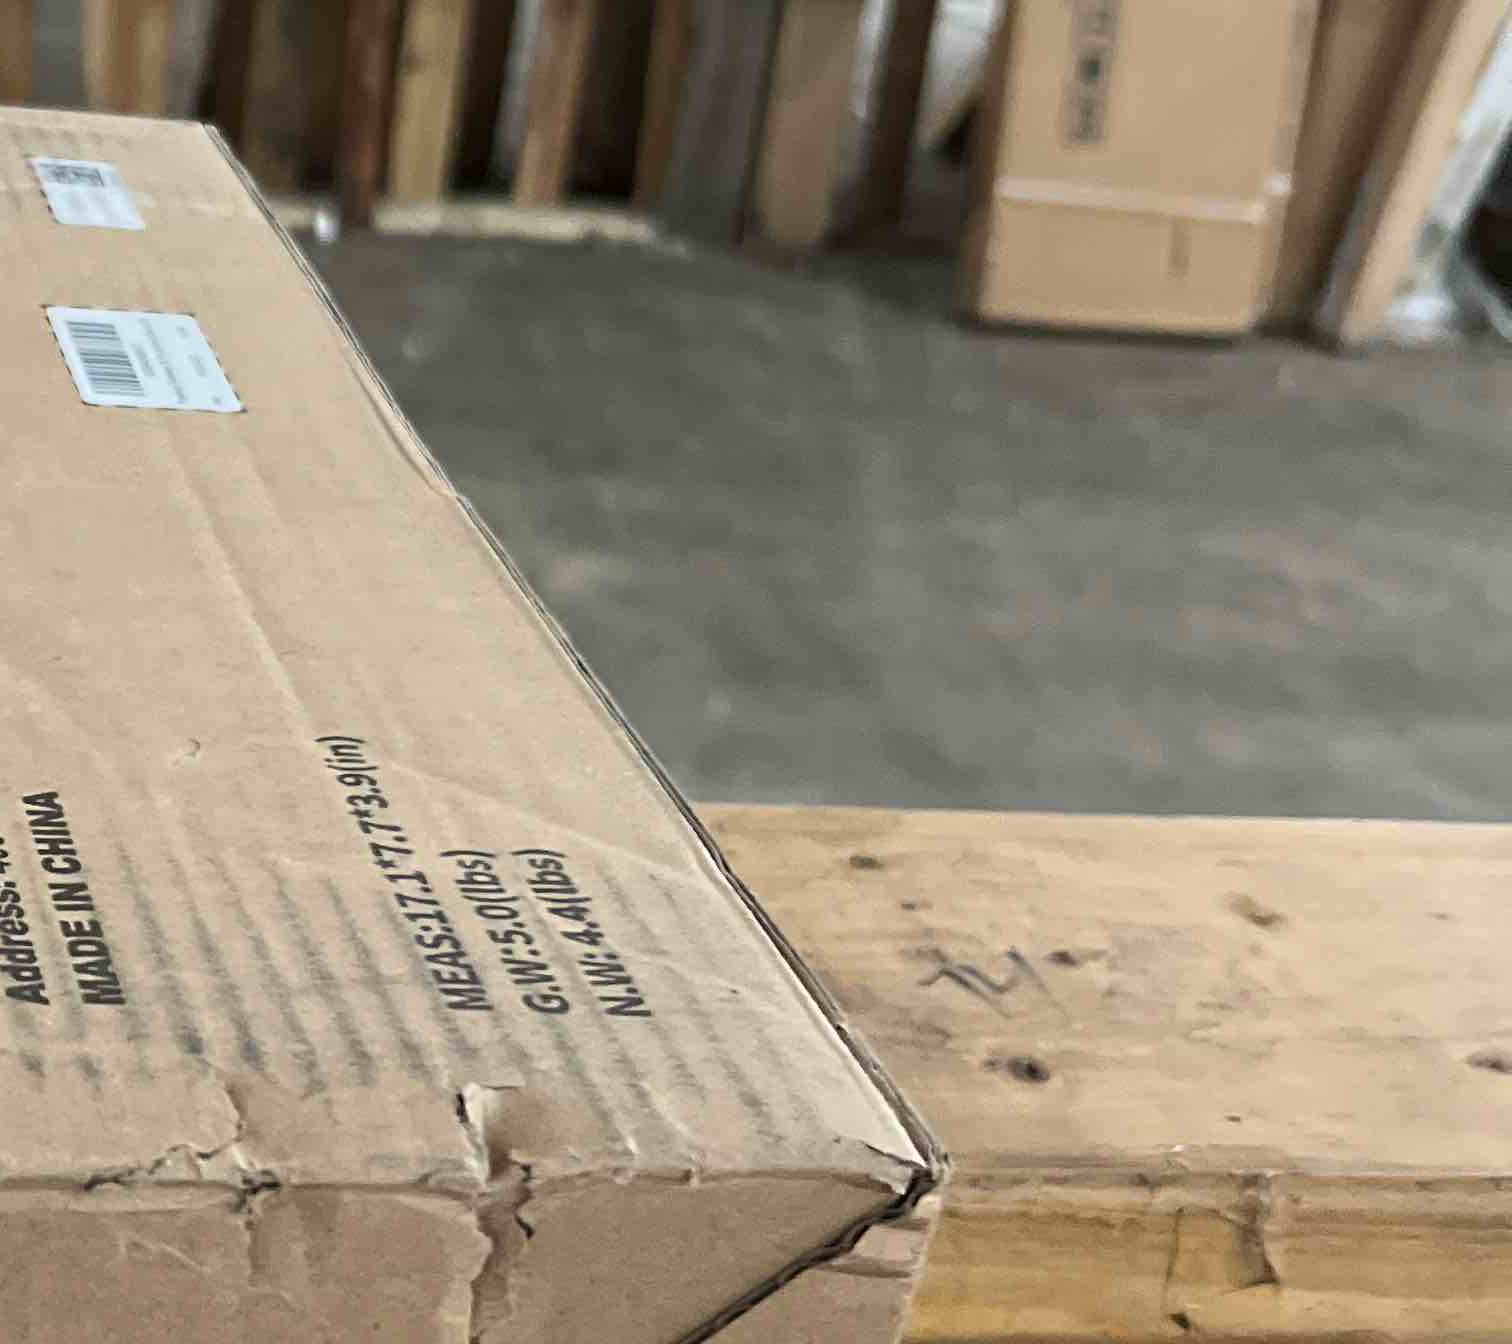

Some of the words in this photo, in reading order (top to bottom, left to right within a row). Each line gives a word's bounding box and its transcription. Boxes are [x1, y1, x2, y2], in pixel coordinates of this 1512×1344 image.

[21, 791, 82, 874] CHINA
[47, 882, 94, 912] IN
[72, 920, 126, 1005] MADE
